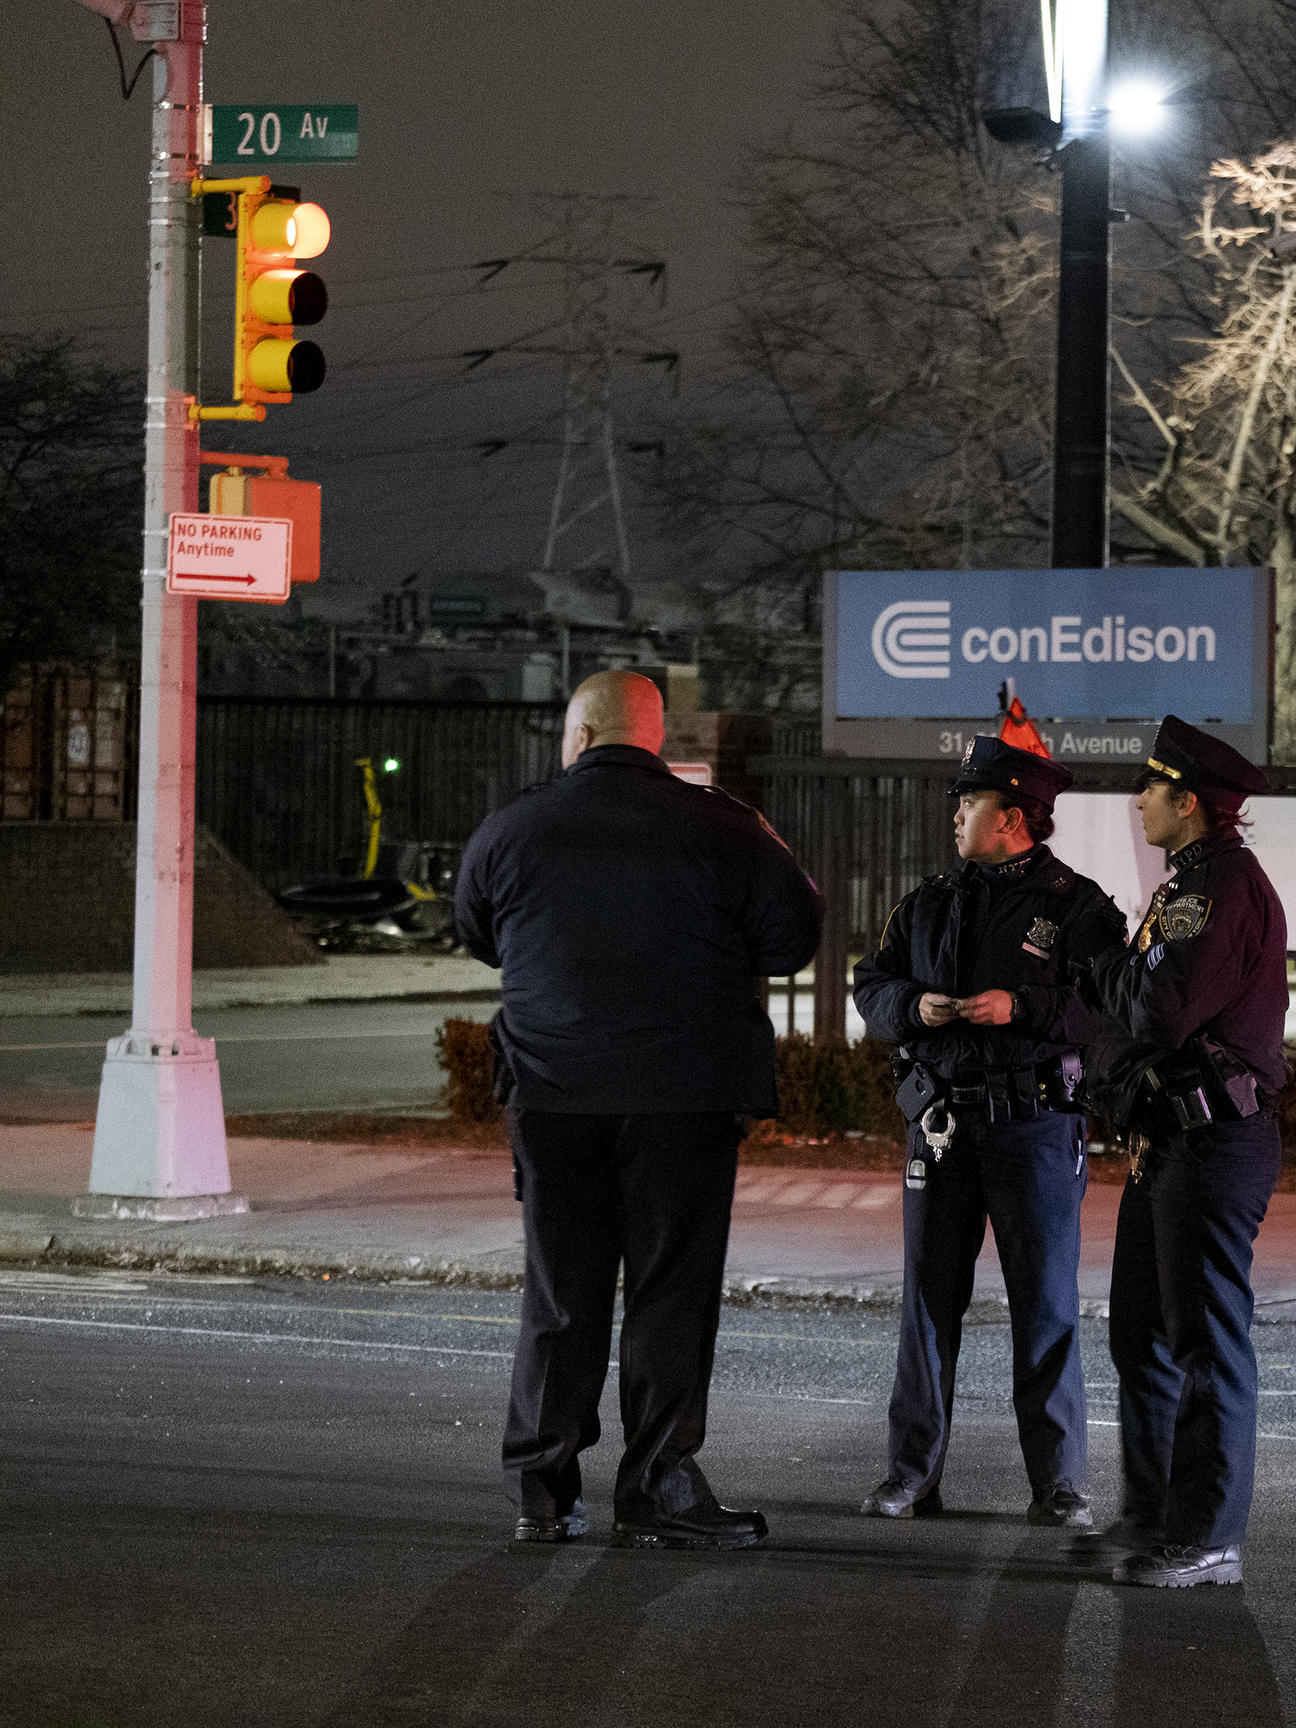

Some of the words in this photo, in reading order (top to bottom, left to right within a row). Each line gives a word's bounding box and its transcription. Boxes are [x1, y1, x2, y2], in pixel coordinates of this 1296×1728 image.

[237, 112, 281, 156] 20
[300, 112, 328, 138] Av
[177, 523, 197, 537] NO
[201, 524, 262, 541] PARKING
[177, 541, 235, 558] Anytime
[961, 616, 1216, 663] conEdison
[1060, 732, 1143, 755] Avenue
